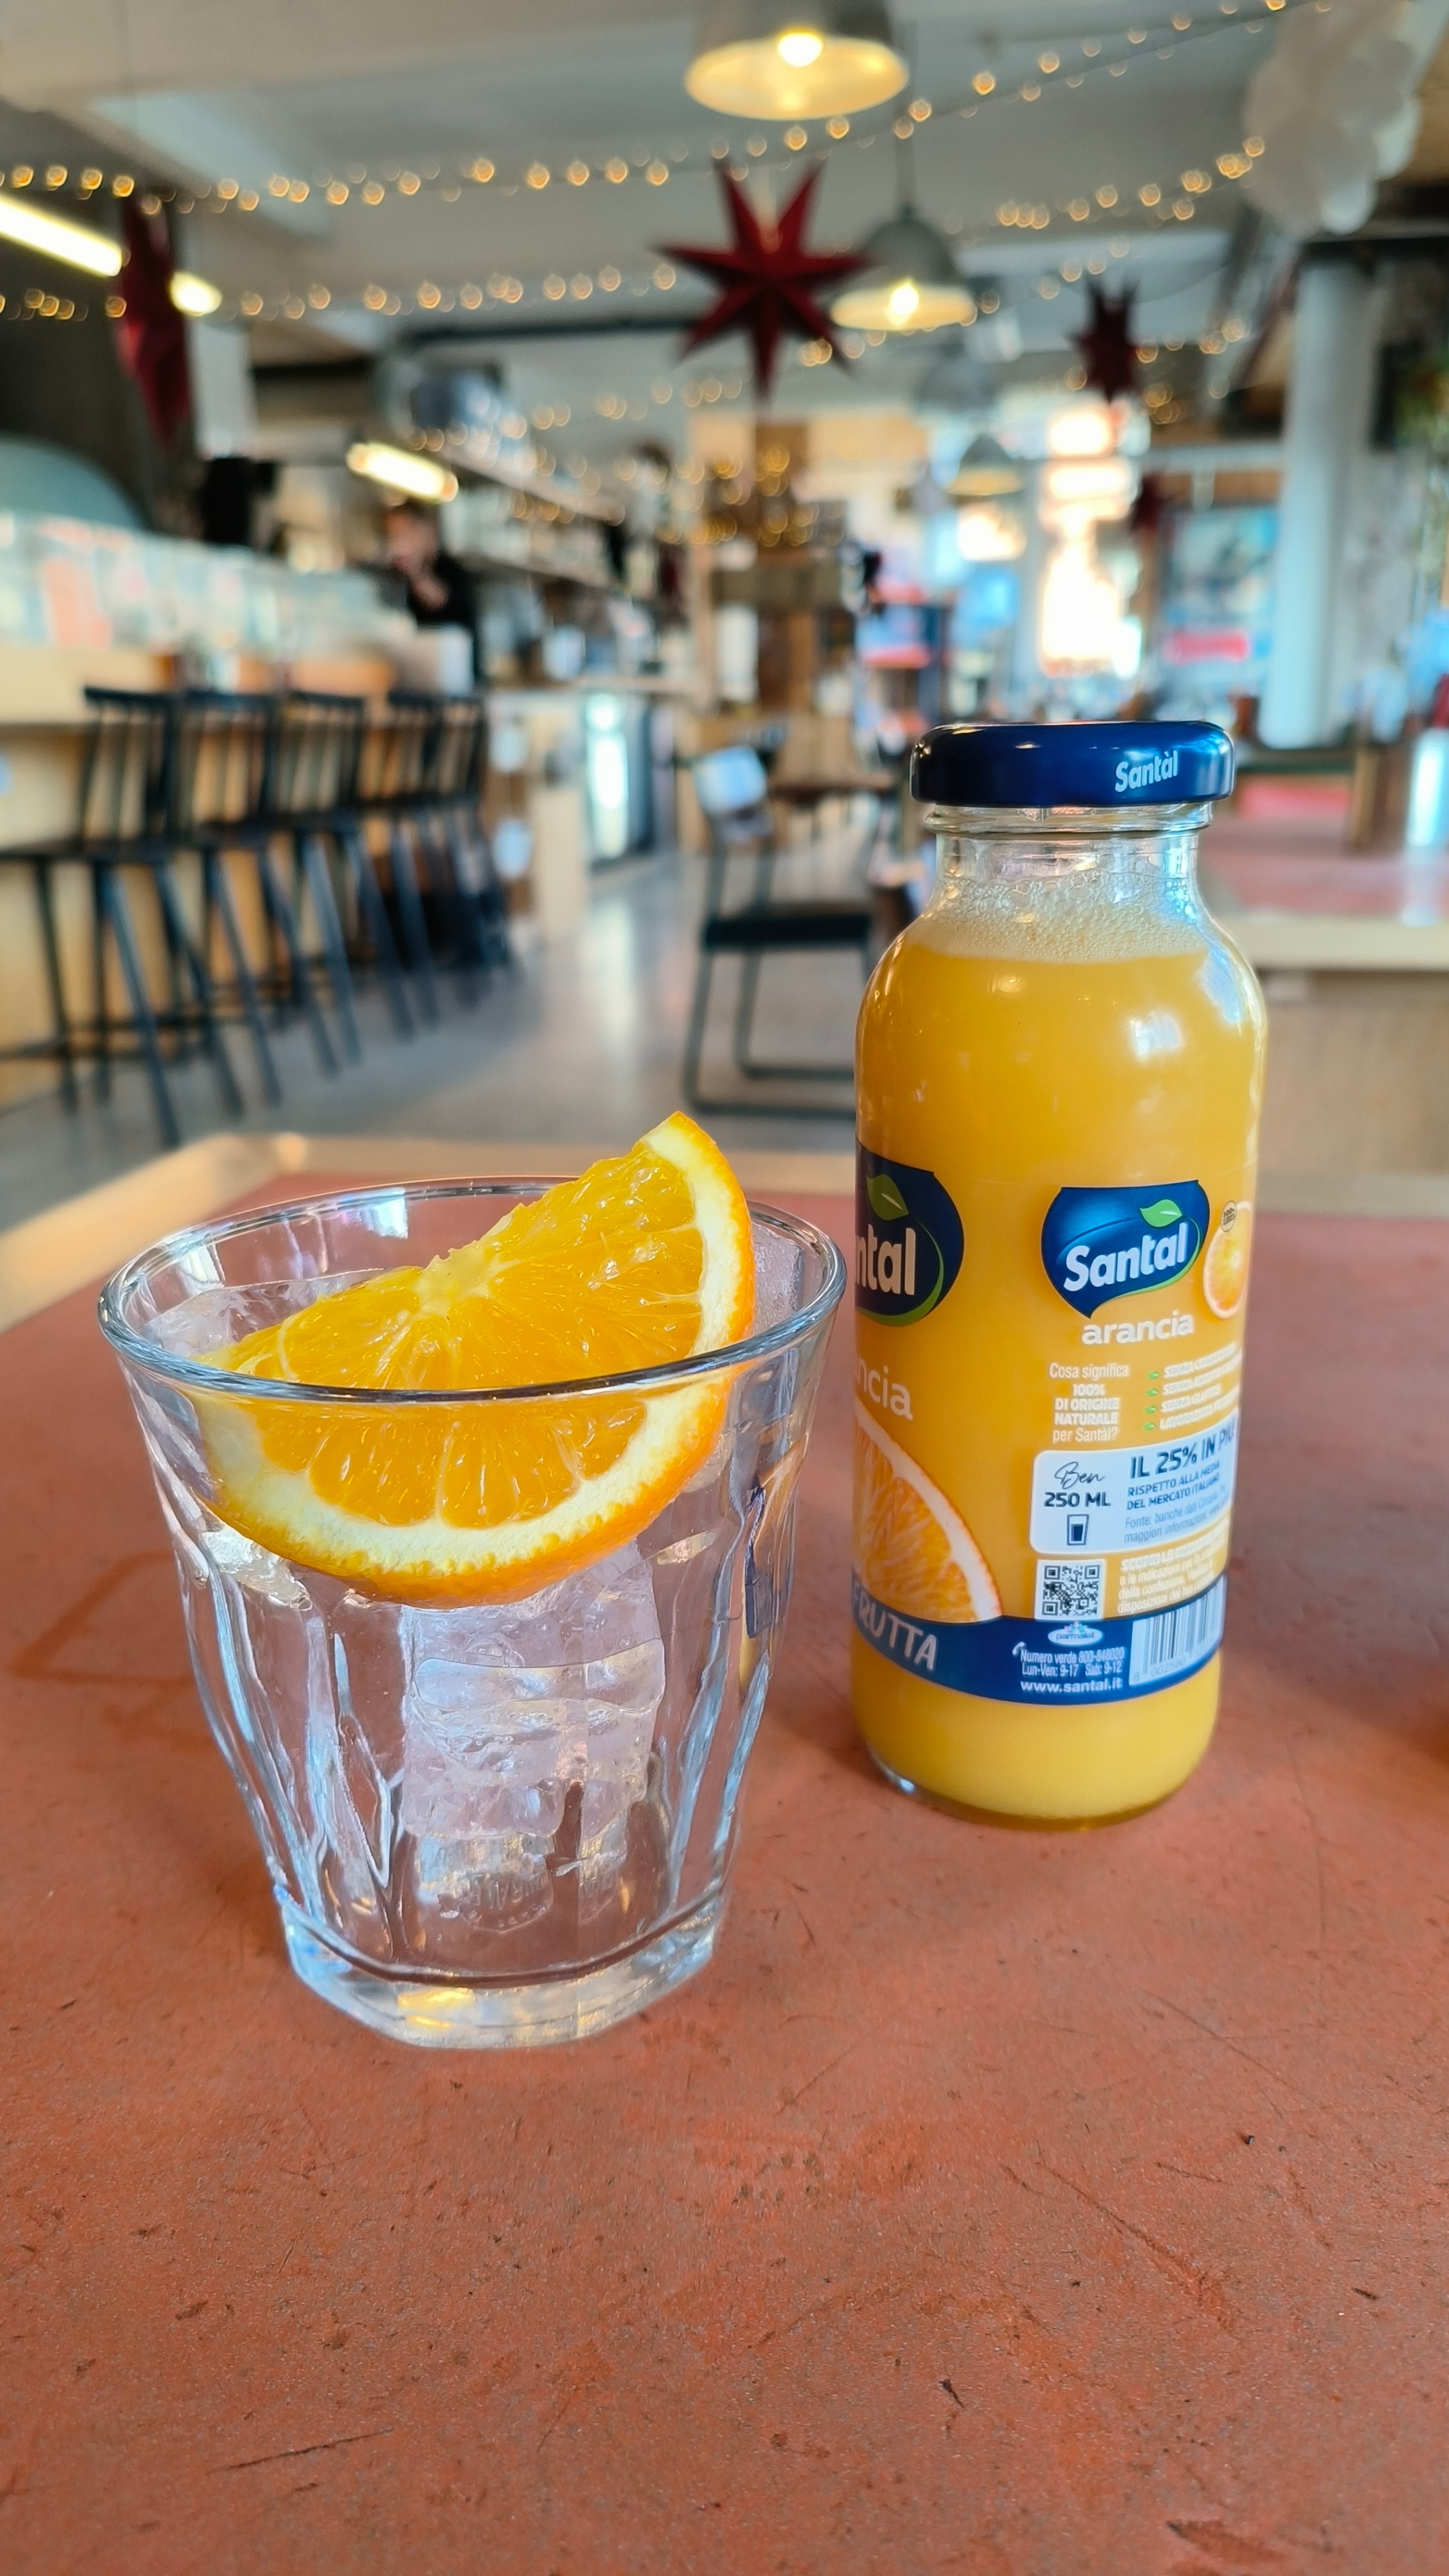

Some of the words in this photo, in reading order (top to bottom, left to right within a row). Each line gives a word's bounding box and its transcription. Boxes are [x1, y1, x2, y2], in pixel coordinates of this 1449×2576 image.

[1115, 751, 1178, 792] Santàl
[856, 1223, 916, 1296] ntal
[1081, 1310, 1194, 1345] arancia
[1050, 1362, 1079, 1378] Cosa
[1081, 1364, 1129, 1380] significa
[857, 1356, 913, 1421] ncia
[1072, 1384, 1105, 1397] 100%
[1055, 1398, 1068, 1411] DI
[1070, 1397, 1120, 1411] ORIGINE
[1054, 1411, 1119, 1425] NATURALE
[1052, 1430, 1073, 1445] per
[1075, 1427, 1119, 1443] Santàl?
[1130, 1456, 1150, 1479] IL
[1155, 1442, 1197, 1475] 25%
[1201, 1433, 1216, 1461] IN
[1054, 1461, 1105, 1490] Ben
[1128, 1478, 1176, 1497] RISPETTO
[1178, 1471, 1199, 1486] ALLA
[1200, 1459, 1220, 1478] MEDIA
[1044, 1492, 1080, 1507] 250
[1085, 1492, 1111, 1507] ML
[1126, 1498, 1146, 1511] DEL
[1148, 1488, 1191, 1507] MERCATO
[1125, 1515, 1152, 1529] Fonte:
[1155, 1507, 1183, 1524] banche
[1124, 1527, 1162, 1544] maggiori
[1118, 1594, 1168, 1615] disposizioni
[1056, 1631, 1094, 1641] parmalat
[1021, 1649, 1053, 1663] Numero
[1054, 1651, 1077, 1664] verde
[1022, 1662, 1058, 1677] Lun-Ven:
[1060, 1664, 1079, 1678] 9-17
[1085, 1662, 1102, 1676] Sab:
[1104, 1660, 1123, 1675] 9-12
[1021, 1677, 1123, 1693] www.santal.it
